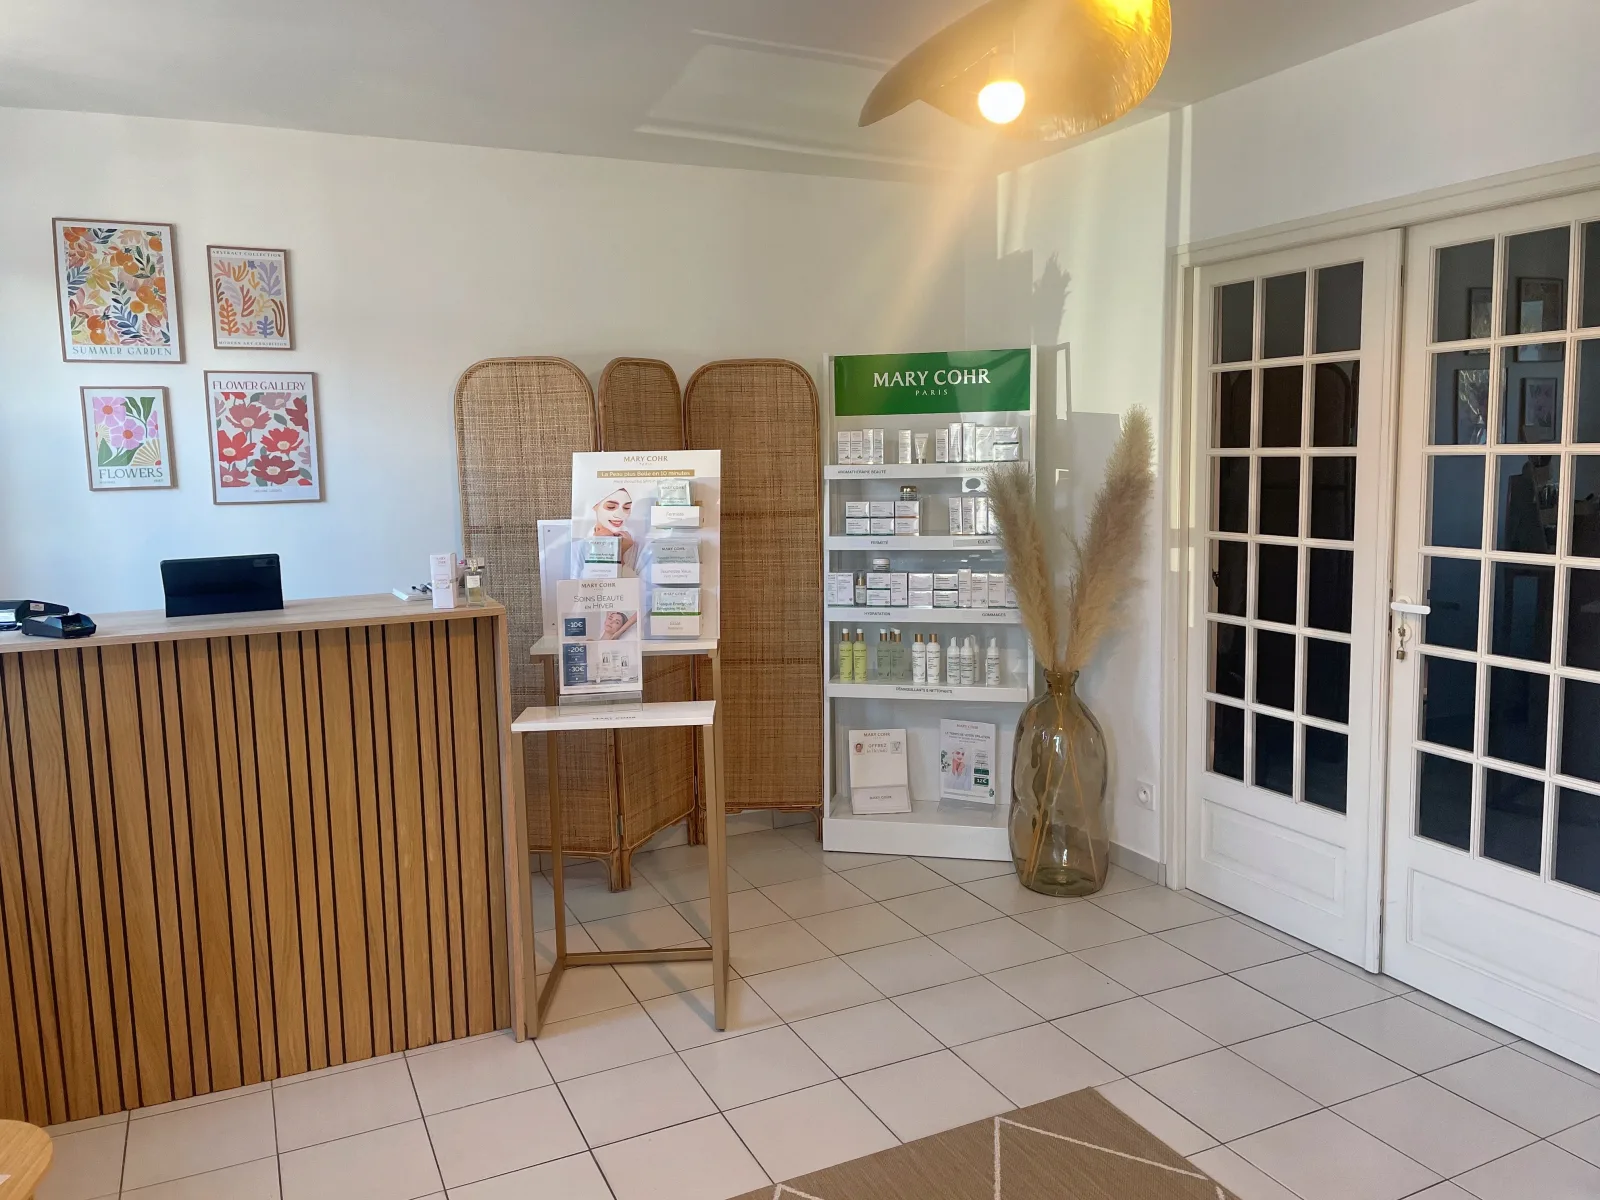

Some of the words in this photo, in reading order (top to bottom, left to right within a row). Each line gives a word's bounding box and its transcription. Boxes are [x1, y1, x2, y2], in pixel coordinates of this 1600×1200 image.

[72, 346, 122, 355] SUMMER
[127, 347, 172, 356] GARDEN
[873, 370, 929, 388] MARY
[933, 368, 991, 386] COHR
[212, 380, 258, 390] FLOWER
[259, 380, 306, 390] GALLERY
[915, 388, 948, 396] PARIS
[98, 467, 163, 479] FLOWERS
